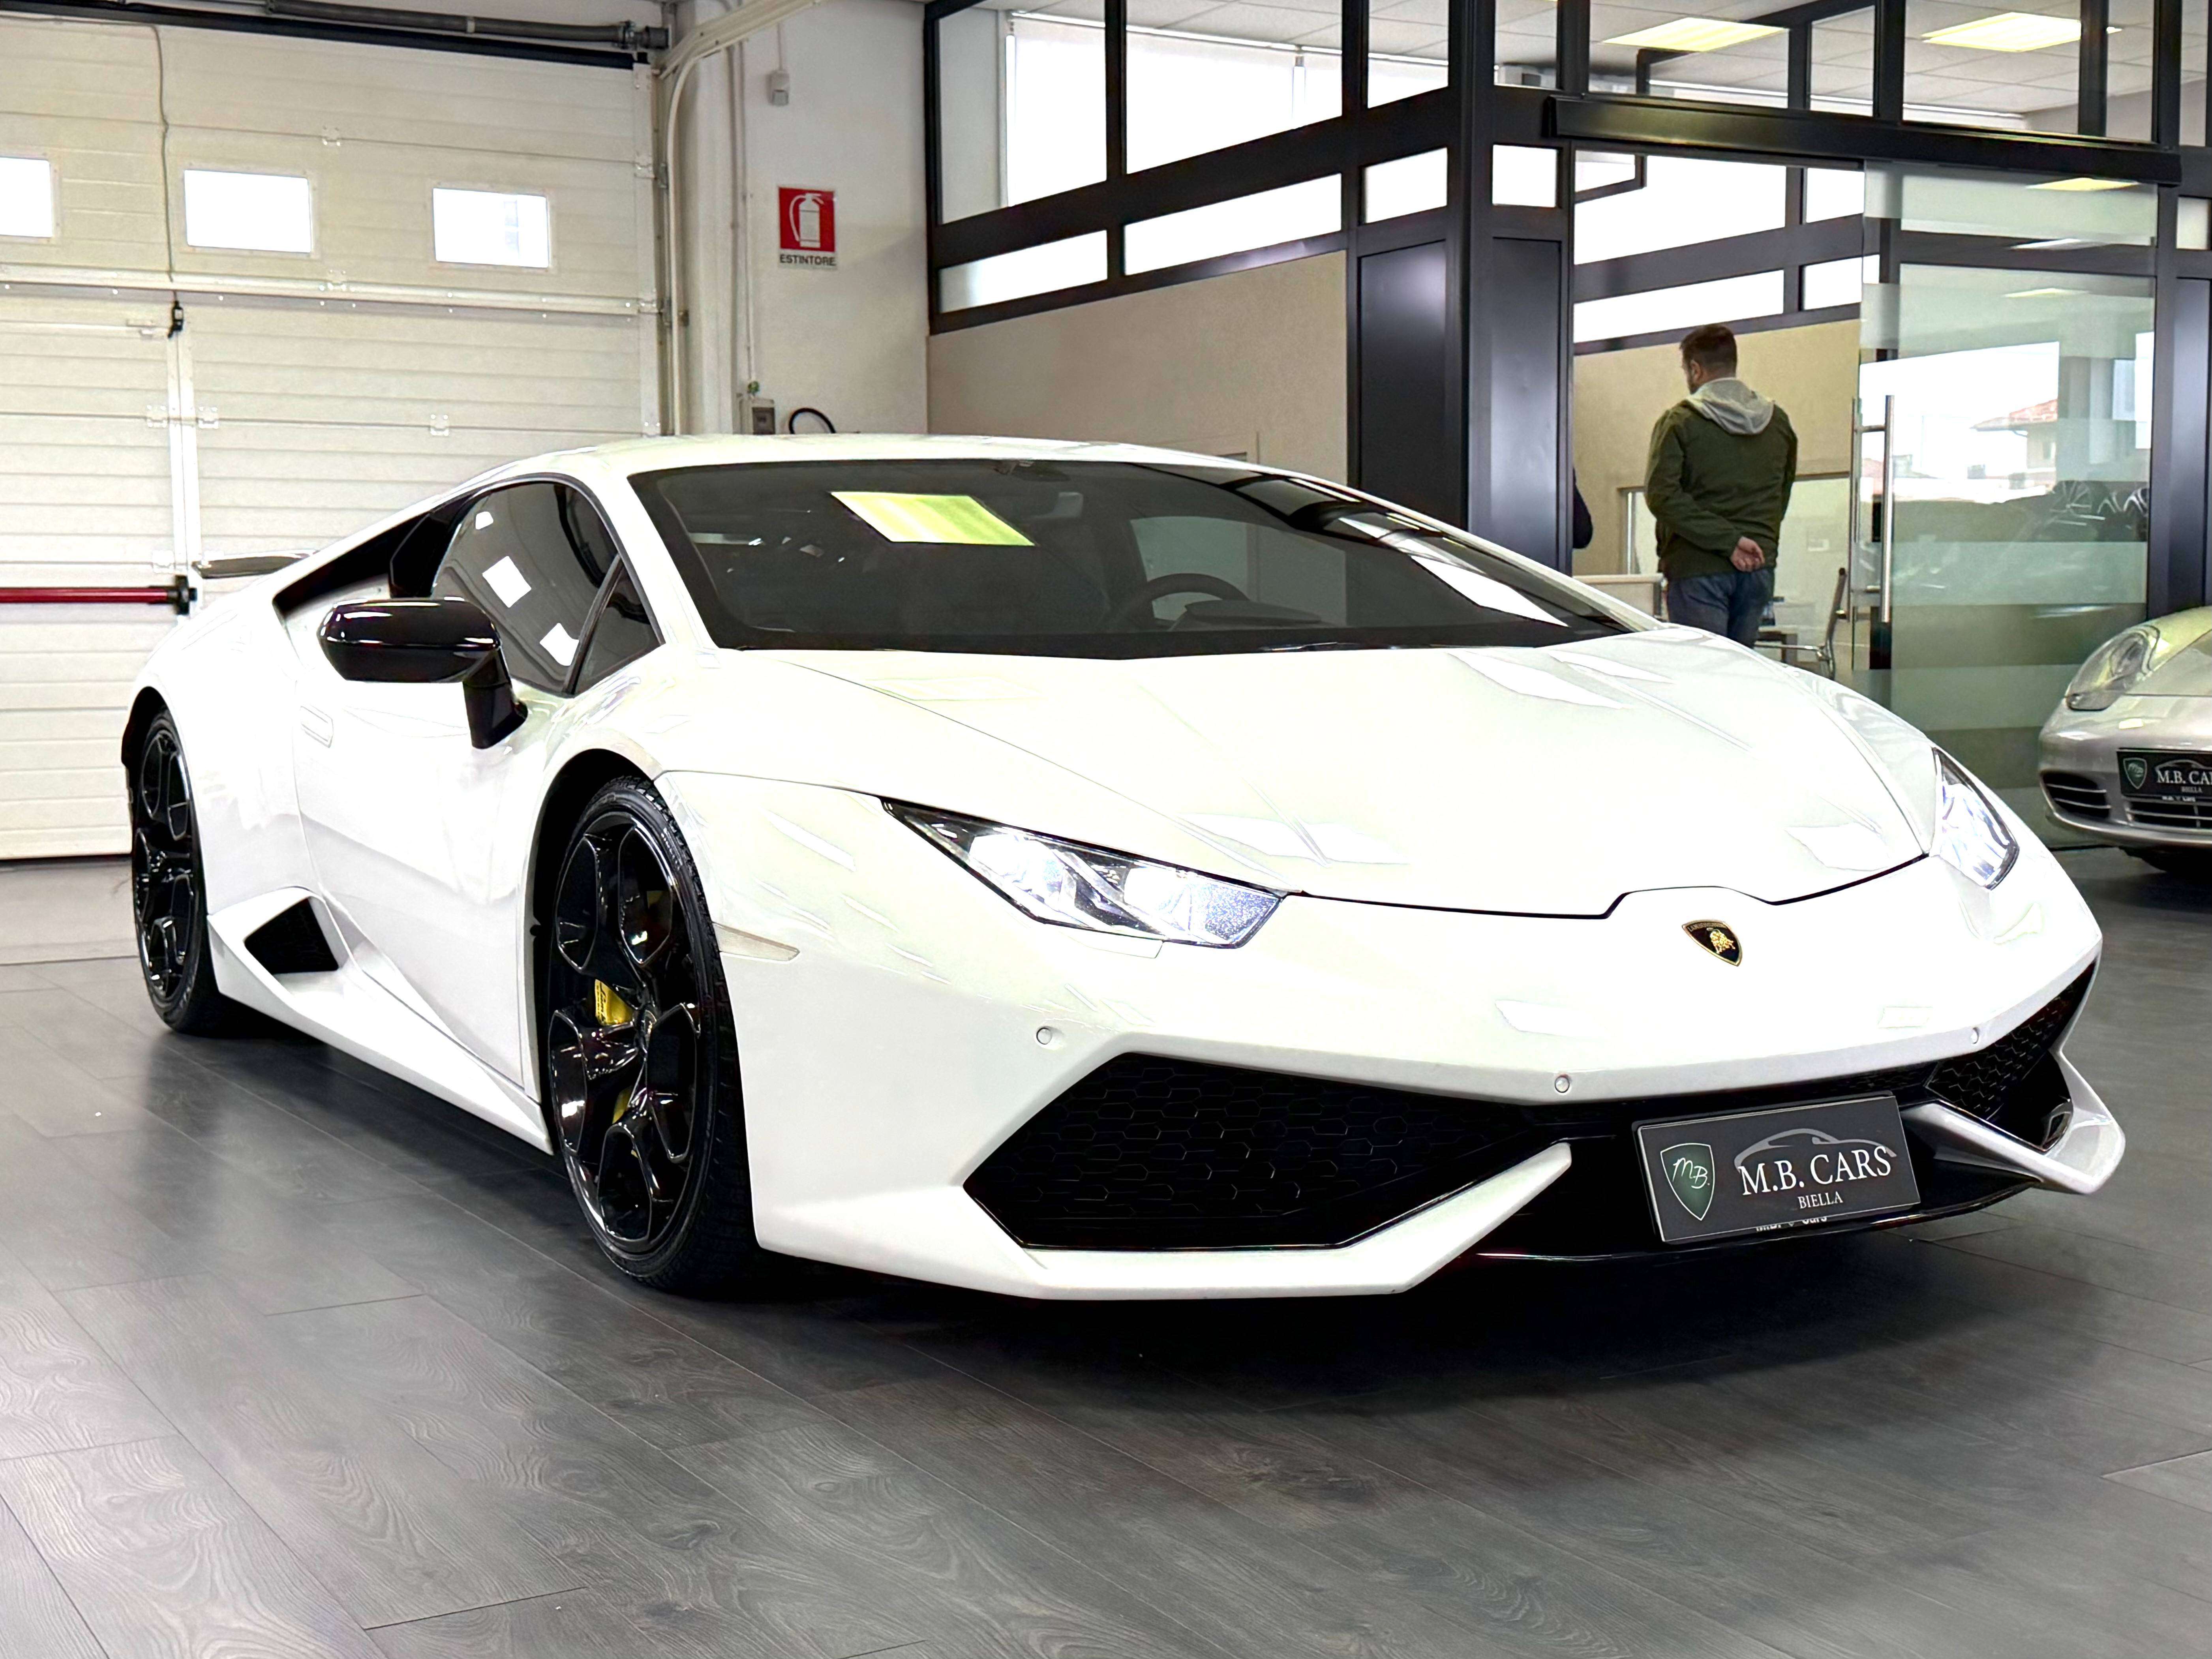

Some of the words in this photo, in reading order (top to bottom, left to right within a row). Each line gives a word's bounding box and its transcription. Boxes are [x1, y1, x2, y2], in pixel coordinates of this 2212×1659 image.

[780, 254, 836, 266] ESTINTORE
[2156, 770, 2186, 784] M.B.
[2189, 771, 2212, 785] CA
[1737, 1160, 1805, 1195] M.B.
[1810, 1146, 1891, 1184] CARS
[1797, 1191, 1843, 1209] BIELLA
